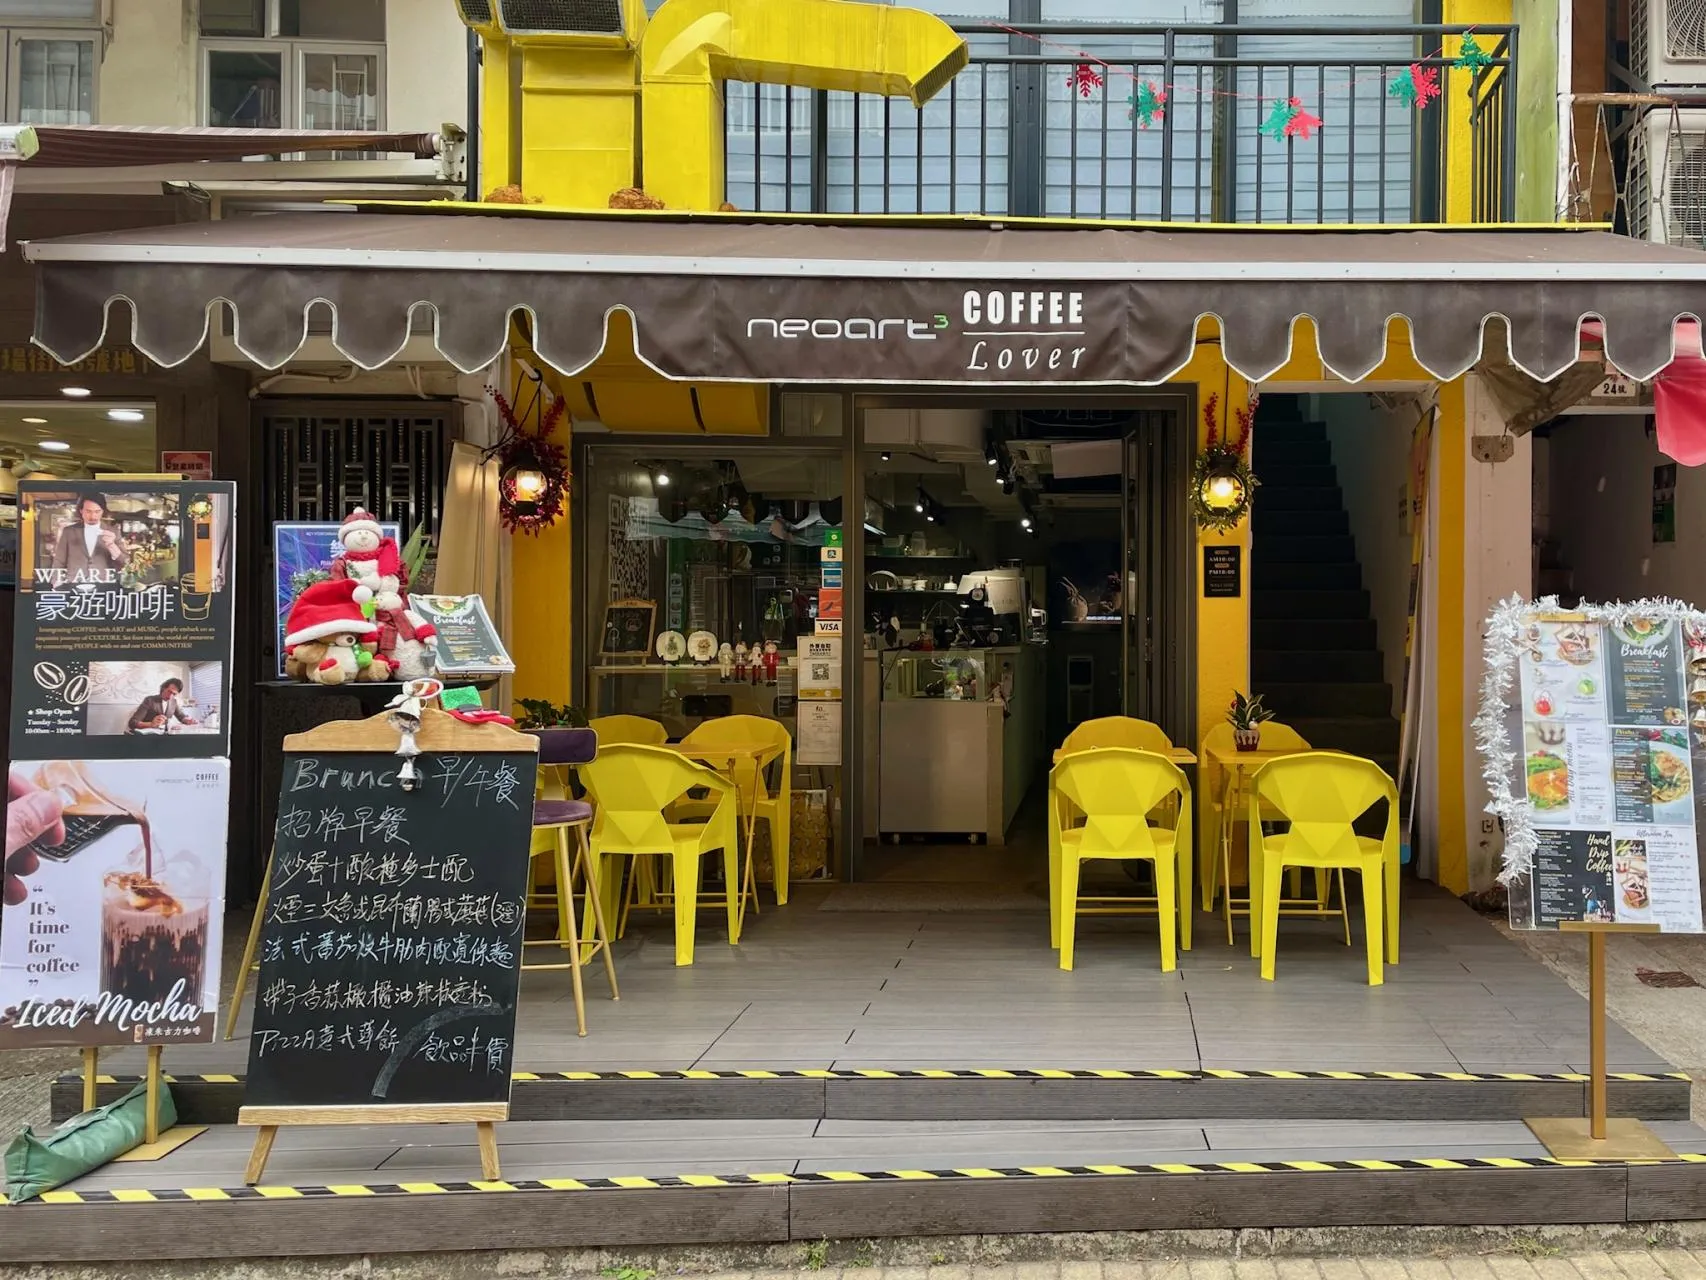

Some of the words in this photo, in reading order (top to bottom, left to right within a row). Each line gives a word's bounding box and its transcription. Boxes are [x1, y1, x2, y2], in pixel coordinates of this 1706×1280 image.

[963, 290, 1083, 325] COFFEE
[967, 341, 1086, 371] Lover
[34, 568, 68, 584] WE
[73, 568, 117, 584] ARE
[35, 588, 175, 621] 豪遊咖啡
[433, 615, 477, 625] Breakfast
[819, 623, 839, 631] VISA
[1620, 643, 1669, 659] Breakfast
[35, 708, 53, 716] Shop
[53, 708, 73, 716] Open
[27, 718, 51, 727] Tuesday
[56, 718, 79, 727] Sunday
[281, 803, 411, 845] 招牌早餐
[1587, 833, 1611, 846] Hand
[1588, 846, 1609, 859] Drip
[1586, 858, 1613, 873] Coffee
[29, 901, 56, 916] It's
[28, 920, 70, 935] time
[27, 939, 56, 954] for
[26, 958, 80, 973] coffee
[12, 994, 88, 1029] Iced
[95, 978, 202, 1032] Mocha
